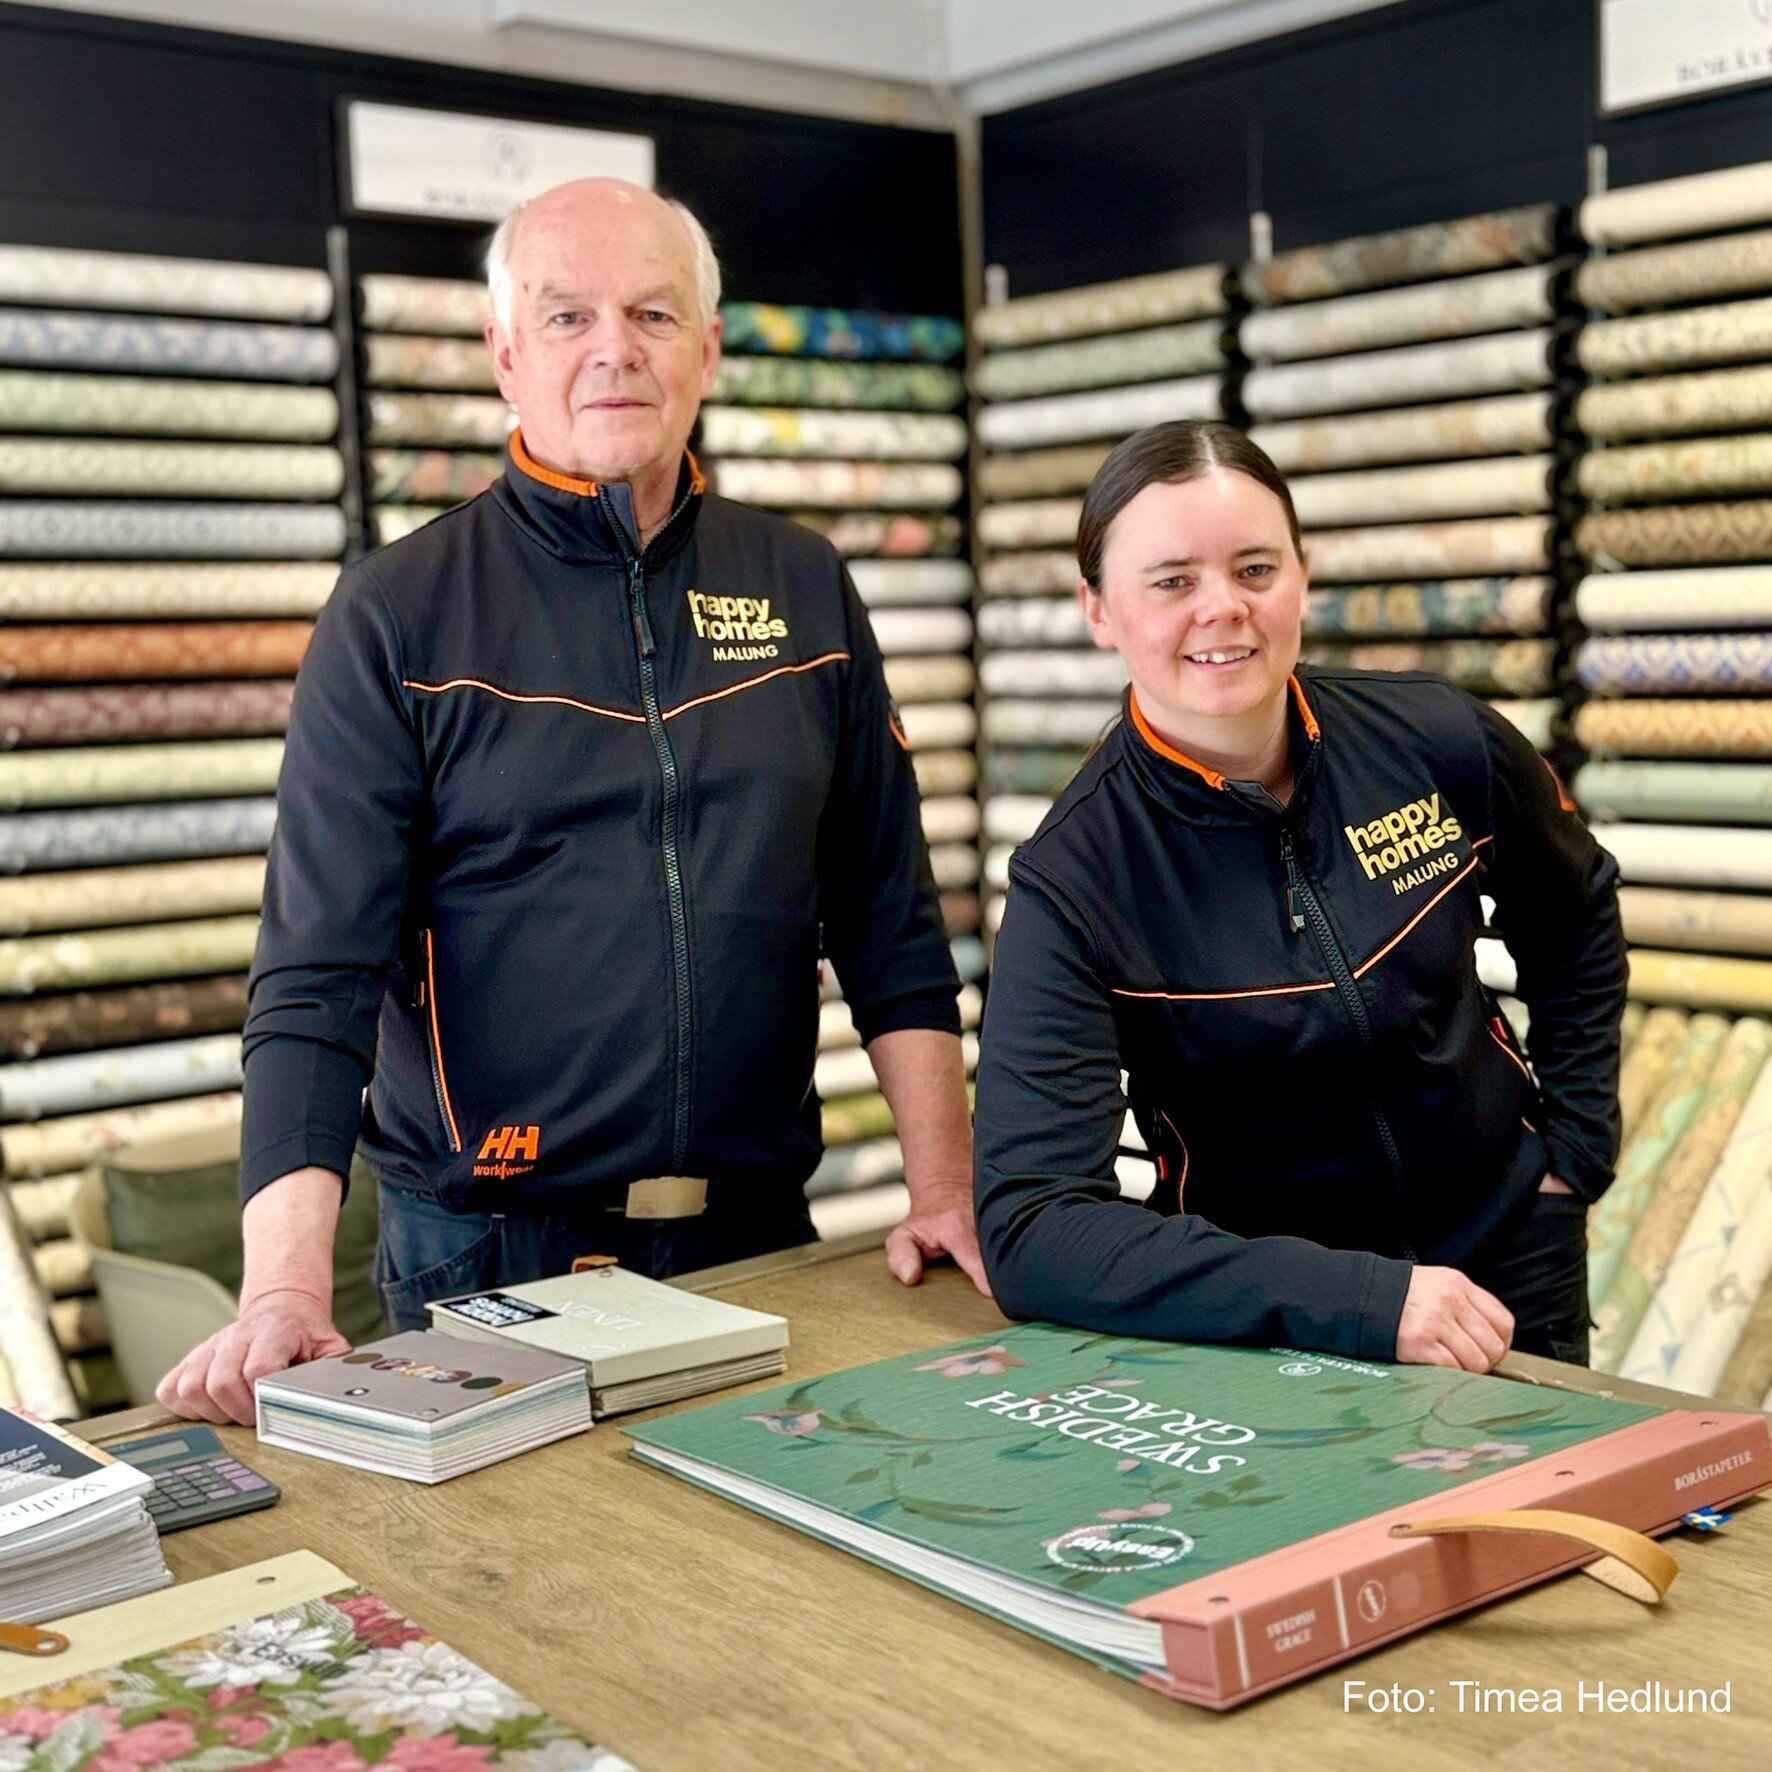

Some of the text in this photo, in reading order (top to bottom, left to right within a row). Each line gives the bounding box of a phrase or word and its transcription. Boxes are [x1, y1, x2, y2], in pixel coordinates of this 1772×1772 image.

[686, 589, 770, 622] happy
[692, 612, 789, 641] homes
[712, 644, 779, 662] MALUNG
[1343, 792, 1441, 854] happy
[1357, 816, 1463, 881] homes
[1391, 852, 1459, 896] MALUNG
[477, 1125, 540, 1160] HH
[964, 1390, 1247, 1474] SWEDISH
[1050, 1384, 1257, 1446] GRACE
[1673, 1449, 1754, 1492] BORÅSTAPETER
[1069, 1536, 1176, 1560] EasyUp
